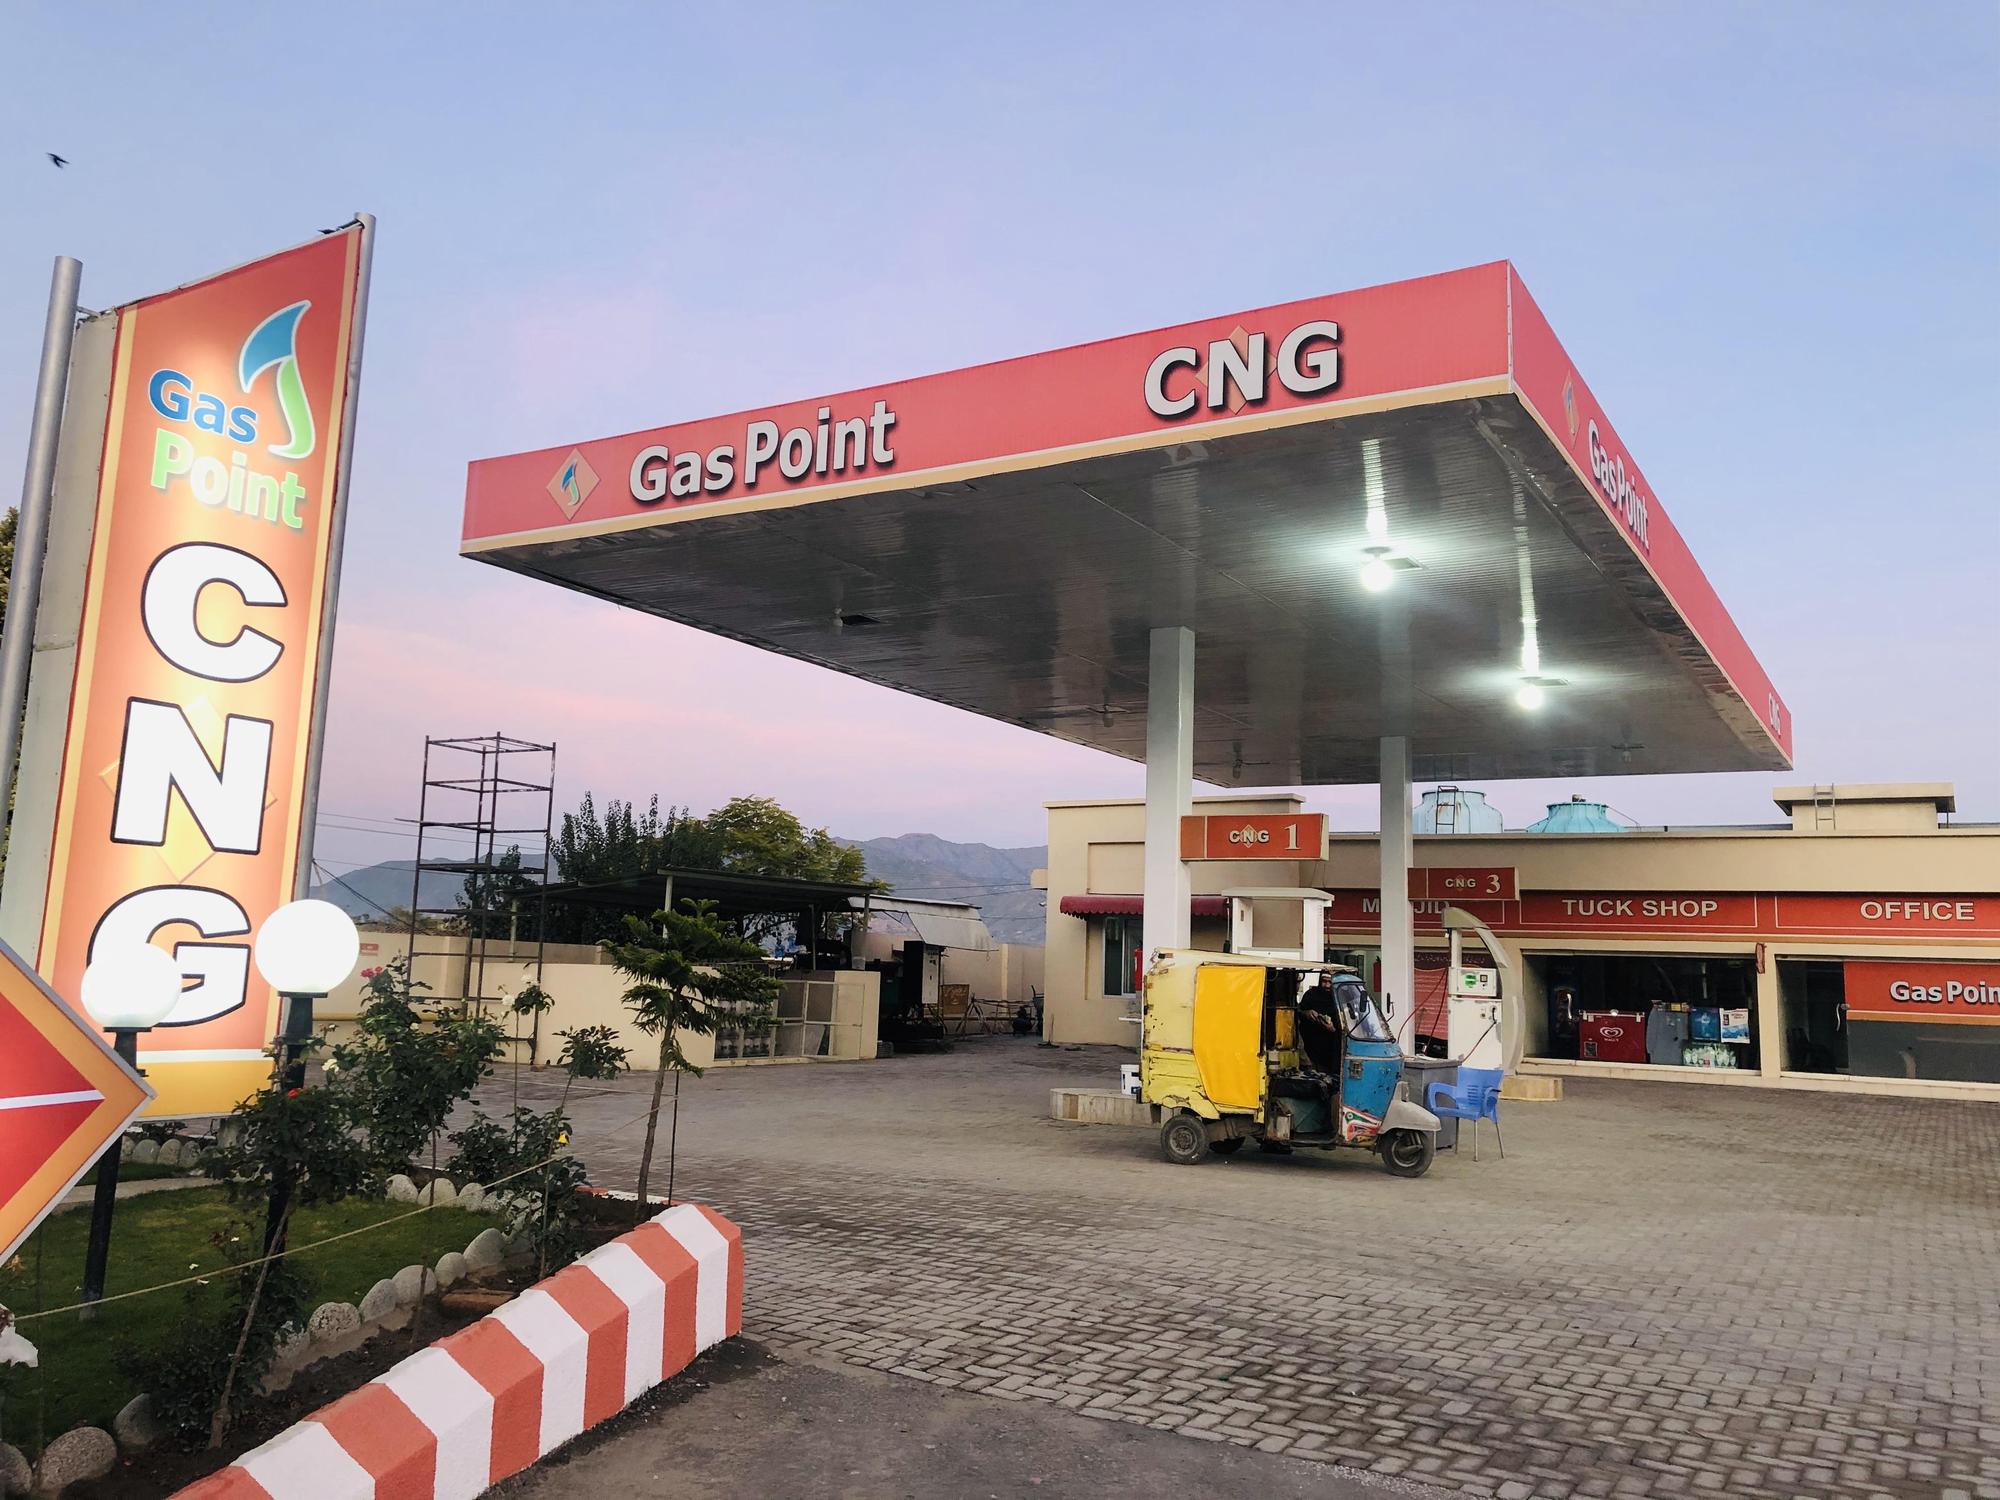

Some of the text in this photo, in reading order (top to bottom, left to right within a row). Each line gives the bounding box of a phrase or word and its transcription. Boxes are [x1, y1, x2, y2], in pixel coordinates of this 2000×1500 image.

[1143, 320, 1339, 417] CNG
[149, 369, 258, 443] Gas
[628, 400, 896, 502] Gas Point
[151, 427, 306, 529] Point
[1588, 418, 1649, 549] Gas Point
[87, 540, 289, 1028] CNG
[1229, 823, 1301, 850] CNG 1
[1362, 898, 1450, 914] MJID
[1445, 874, 1501, 894] CNG 3
[1562, 899, 1719, 918] TUCK SHOP
[1860, 901, 1976, 921] OFFICE
[1890, 980, 1943, 1002] Gas
